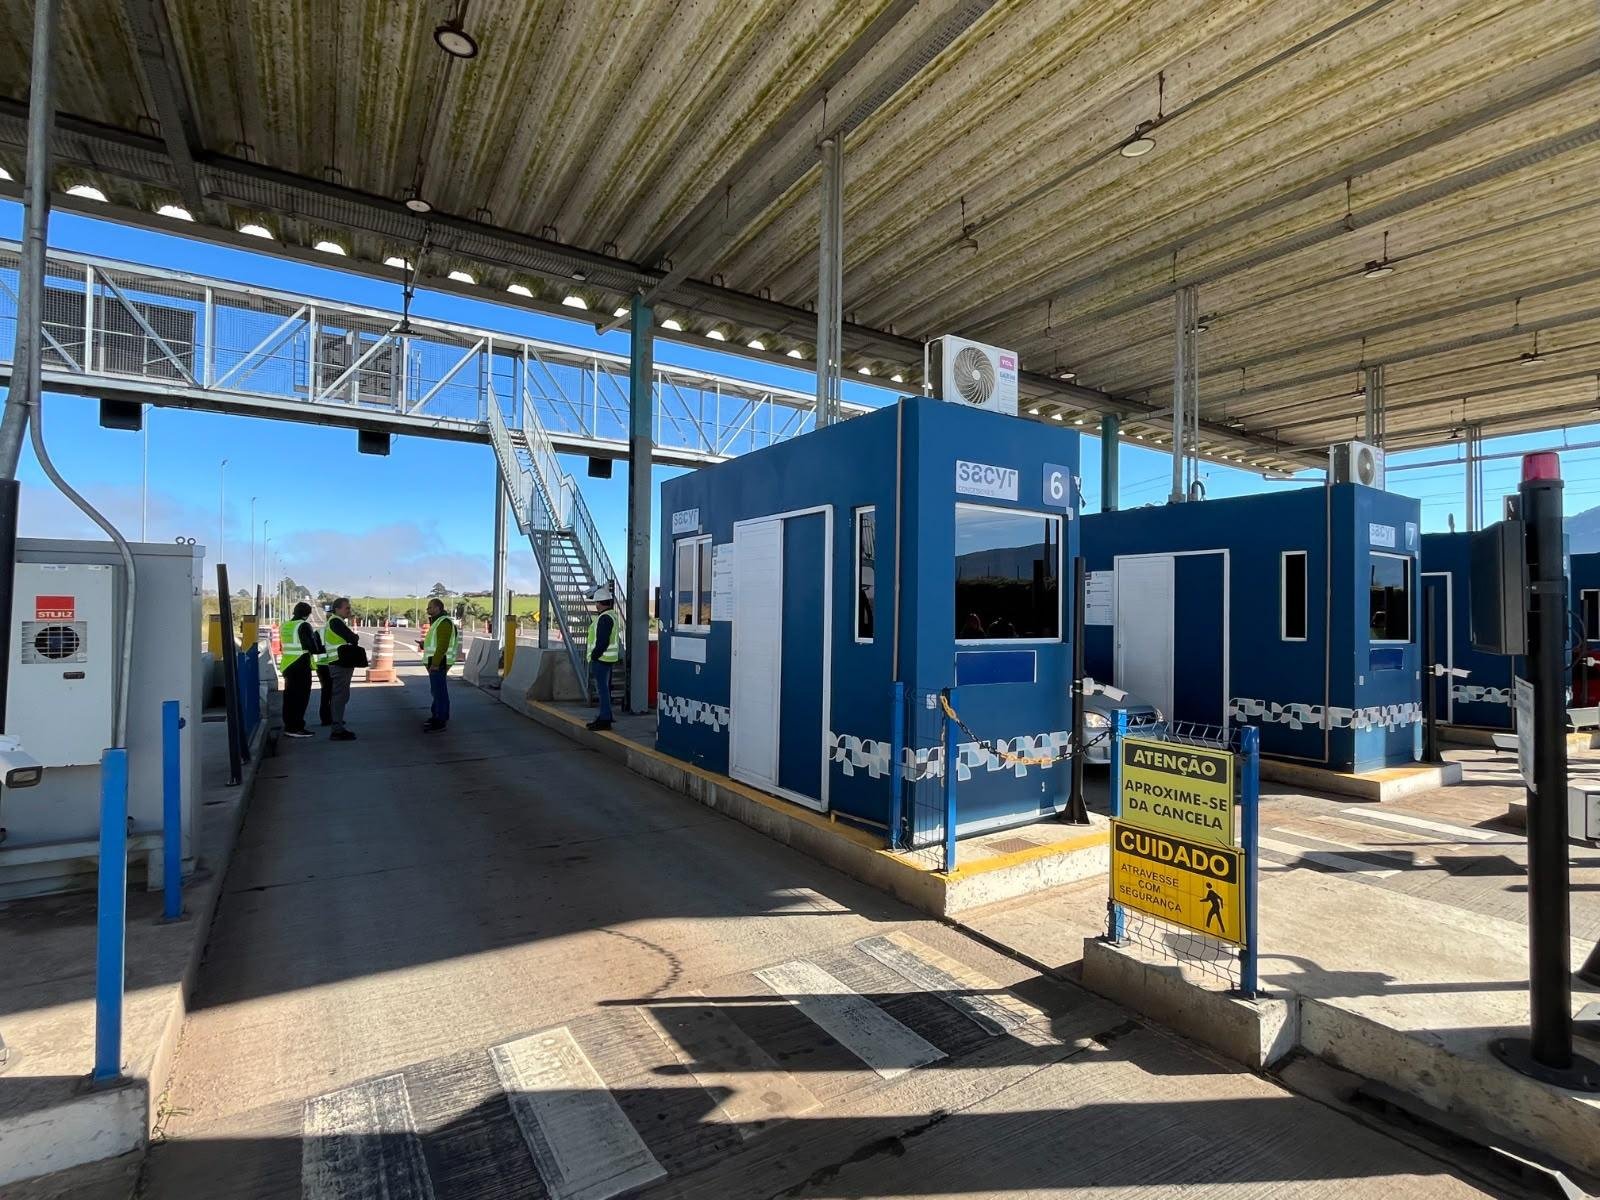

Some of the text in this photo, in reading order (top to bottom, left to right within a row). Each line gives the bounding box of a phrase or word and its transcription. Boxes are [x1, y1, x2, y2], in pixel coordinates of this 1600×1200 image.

[959, 462, 1017, 489] sacyr
[1050, 471, 1064, 500] 6
[673, 510, 698, 526] sacyr
[1370, 524, 1395, 540] sacyr
[1408, 527, 1415, 546] 7
[1133, 749, 1217, 776] ATENÇÃO
[1125, 779, 1228, 812] APROXIME-SE
[1129, 797, 1223, 830] DA CANCELA
[1120, 831, 1229, 877] CUIDADO
[1121, 863, 1180, 888] ATRAVESSE
[1138, 879, 1161, 894] COM
[1119, 885, 1182, 913] SEGURANÇA
